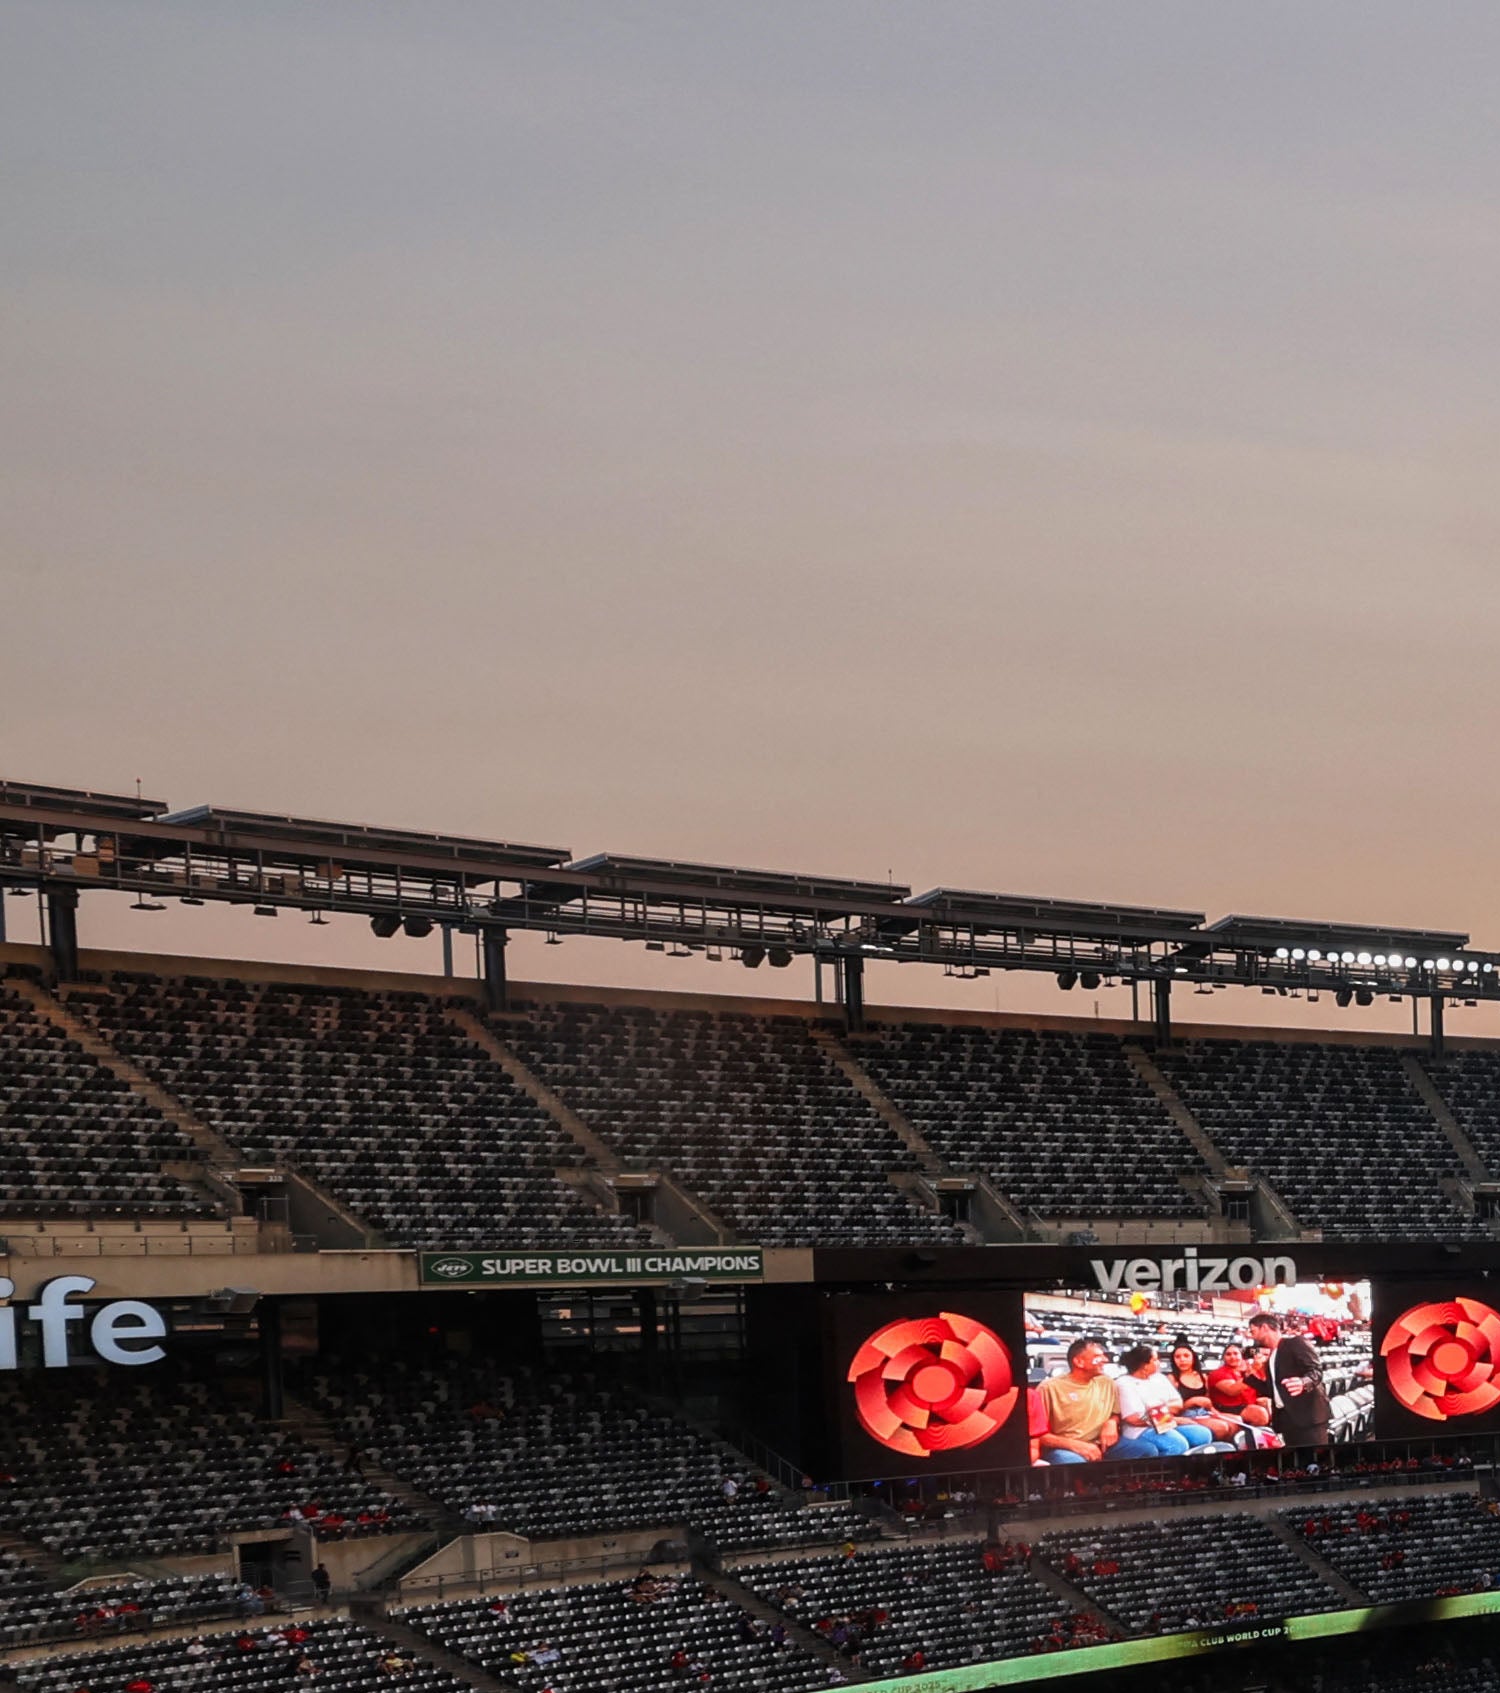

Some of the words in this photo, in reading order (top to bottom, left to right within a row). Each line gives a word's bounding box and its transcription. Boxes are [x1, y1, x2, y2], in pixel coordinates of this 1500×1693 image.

[481, 1257, 552, 1275] SUPER
[557, 1256, 623, 1273] BOWL
[626, 1256, 642, 1272] III
[645, 1255, 760, 1273] CHAMPIONS
[1092, 1247, 1297, 1291] verizon
[1226, 1630, 1260, 1643] WORLD
[1261, 1628, 1282, 1638] CUP
